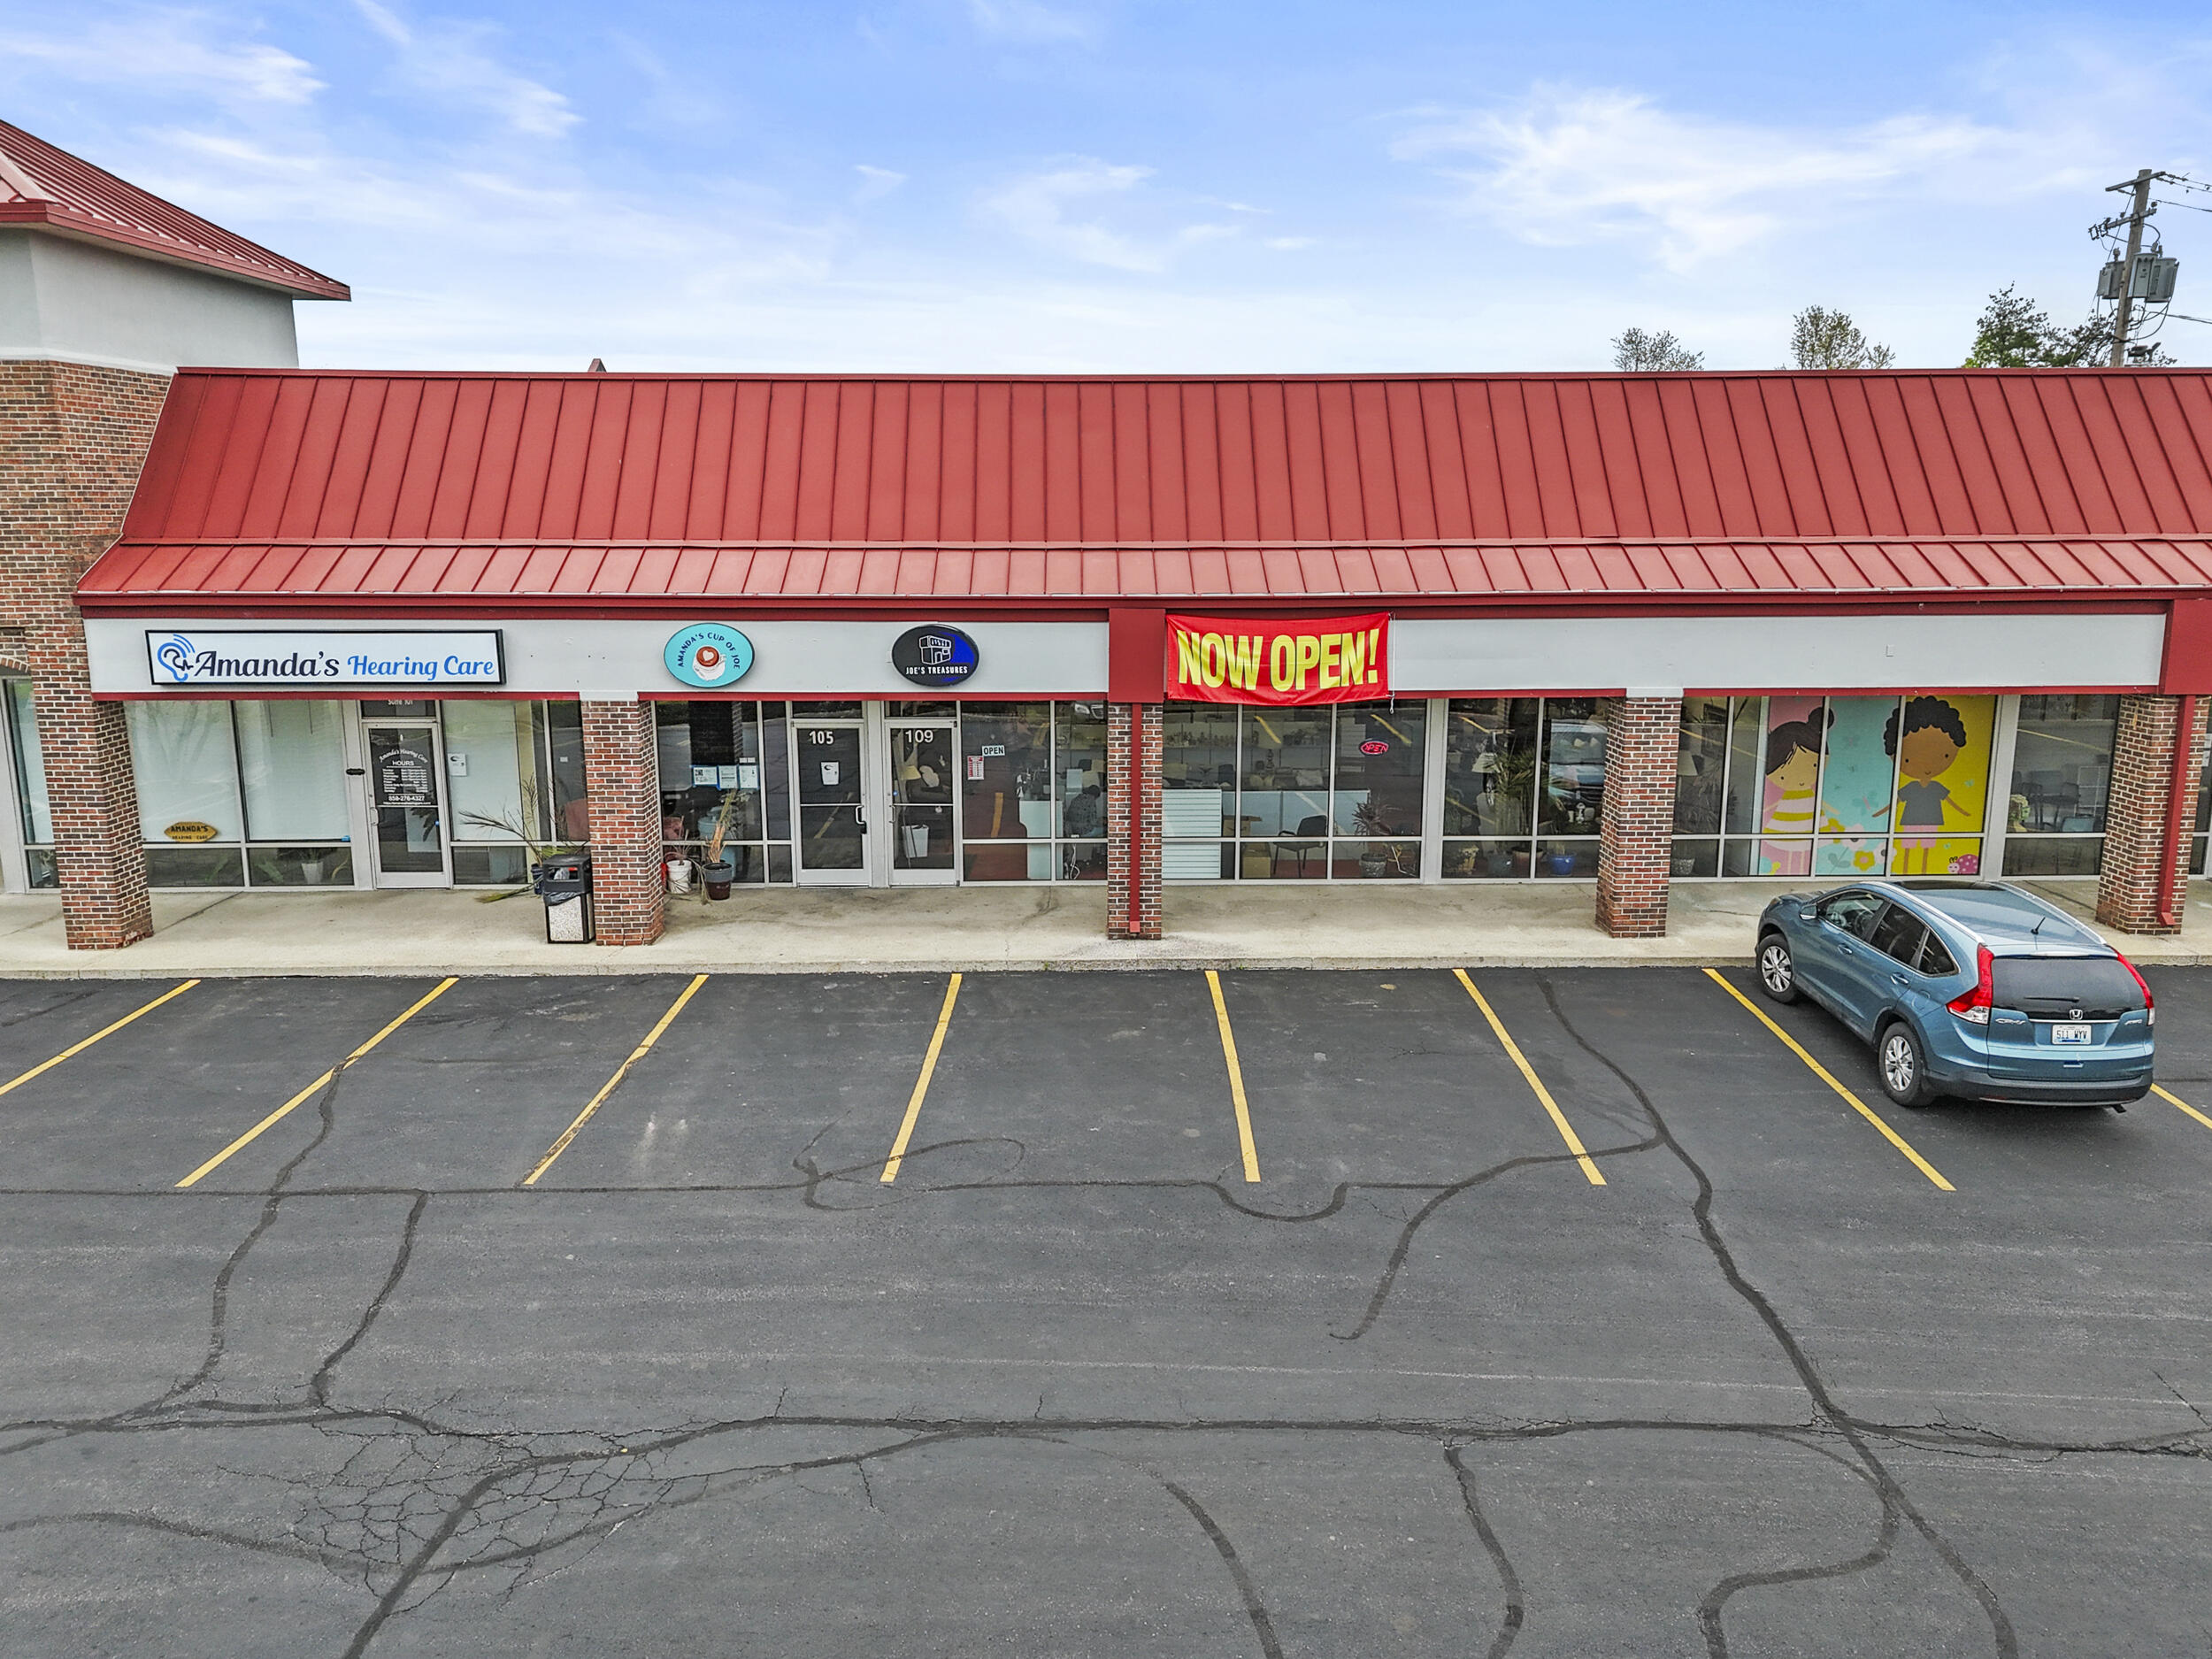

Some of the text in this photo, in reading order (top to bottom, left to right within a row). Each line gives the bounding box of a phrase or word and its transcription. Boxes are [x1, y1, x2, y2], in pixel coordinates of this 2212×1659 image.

[677, 632, 741, 669] AMANDA'S CUP OF JOE
[194, 650, 495, 680] Amanda's Hearing Care
[1177, 628, 1379, 692] NOW OPEN!
[905, 665, 968, 675] JOE'S TREASURES
[809, 730, 834, 744] 105
[905, 729, 933, 743] 109
[983, 746, 1004, 755] OPEN
